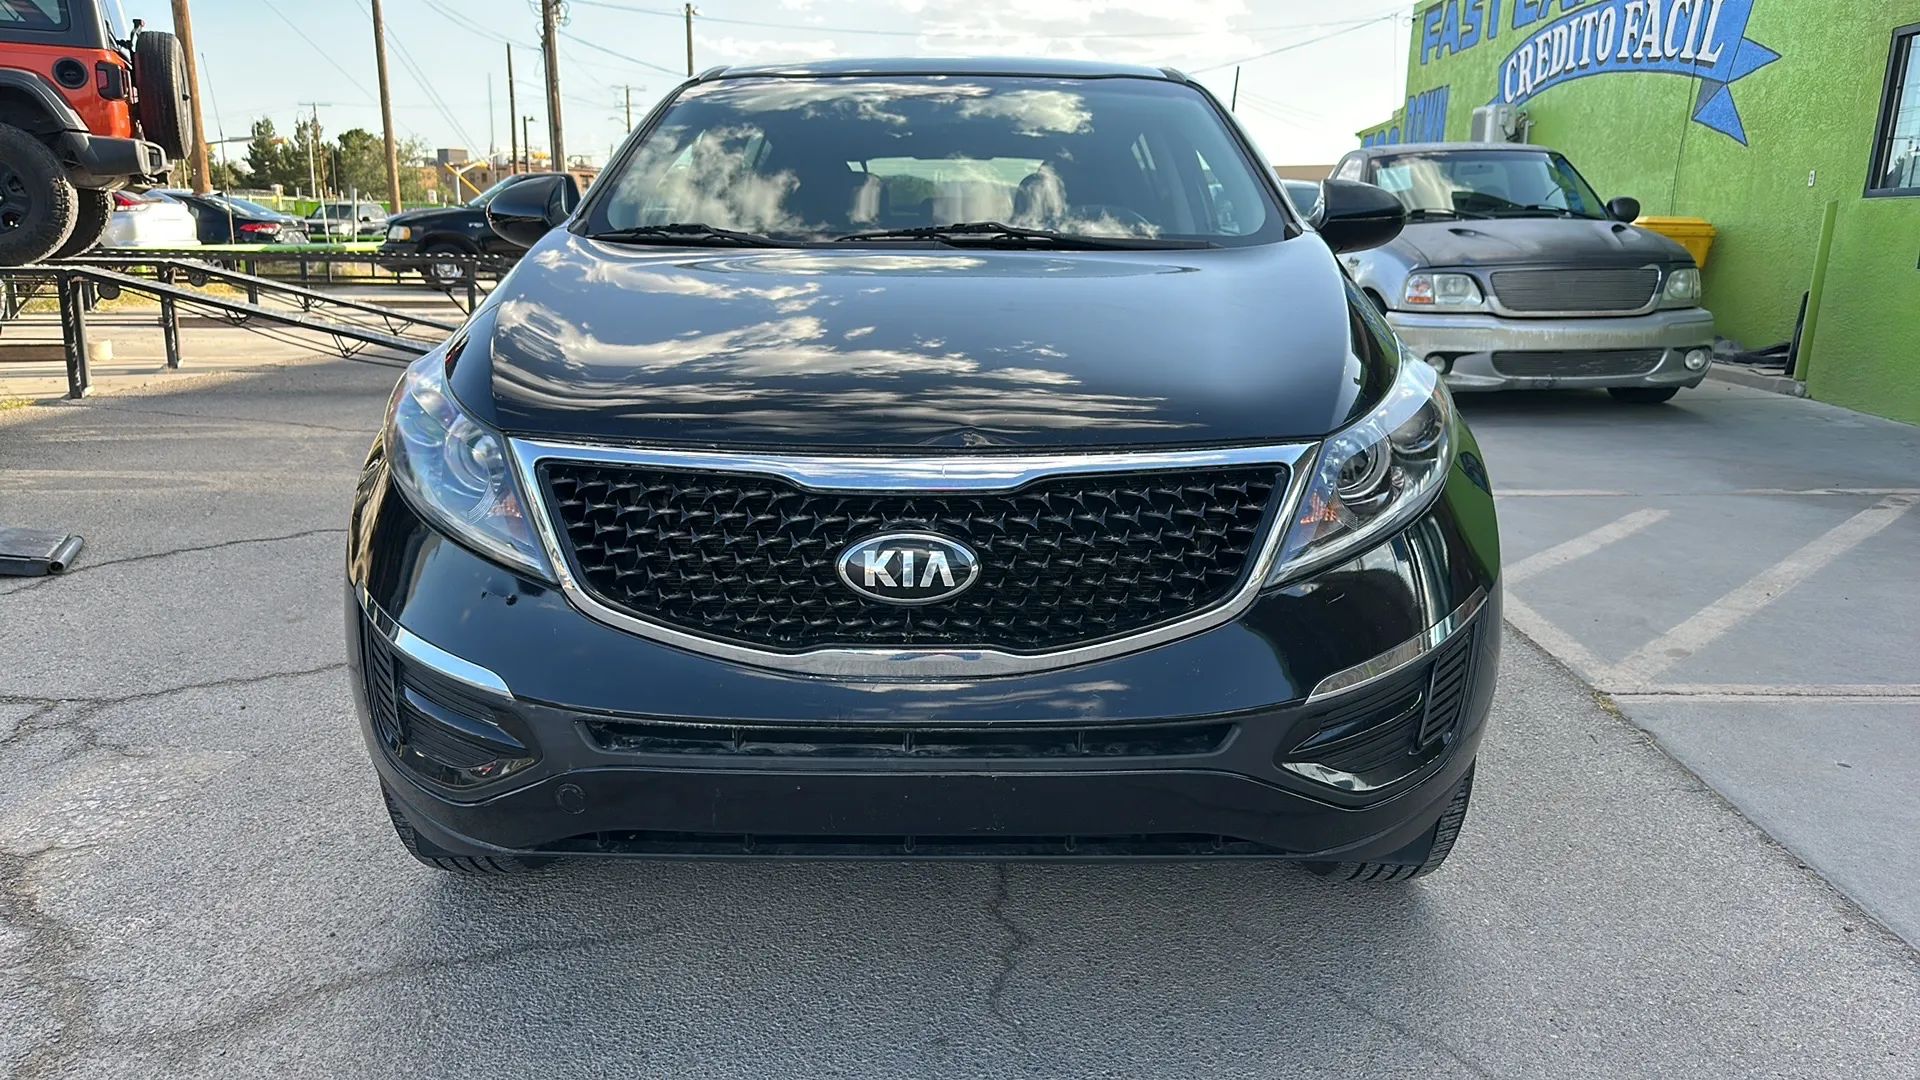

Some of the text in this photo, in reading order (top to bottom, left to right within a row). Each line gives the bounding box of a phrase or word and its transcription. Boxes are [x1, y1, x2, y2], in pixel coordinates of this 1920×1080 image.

[1503, 0, 1724, 104] CREDITO FACIL
[863, 550, 956, 588] KIA
